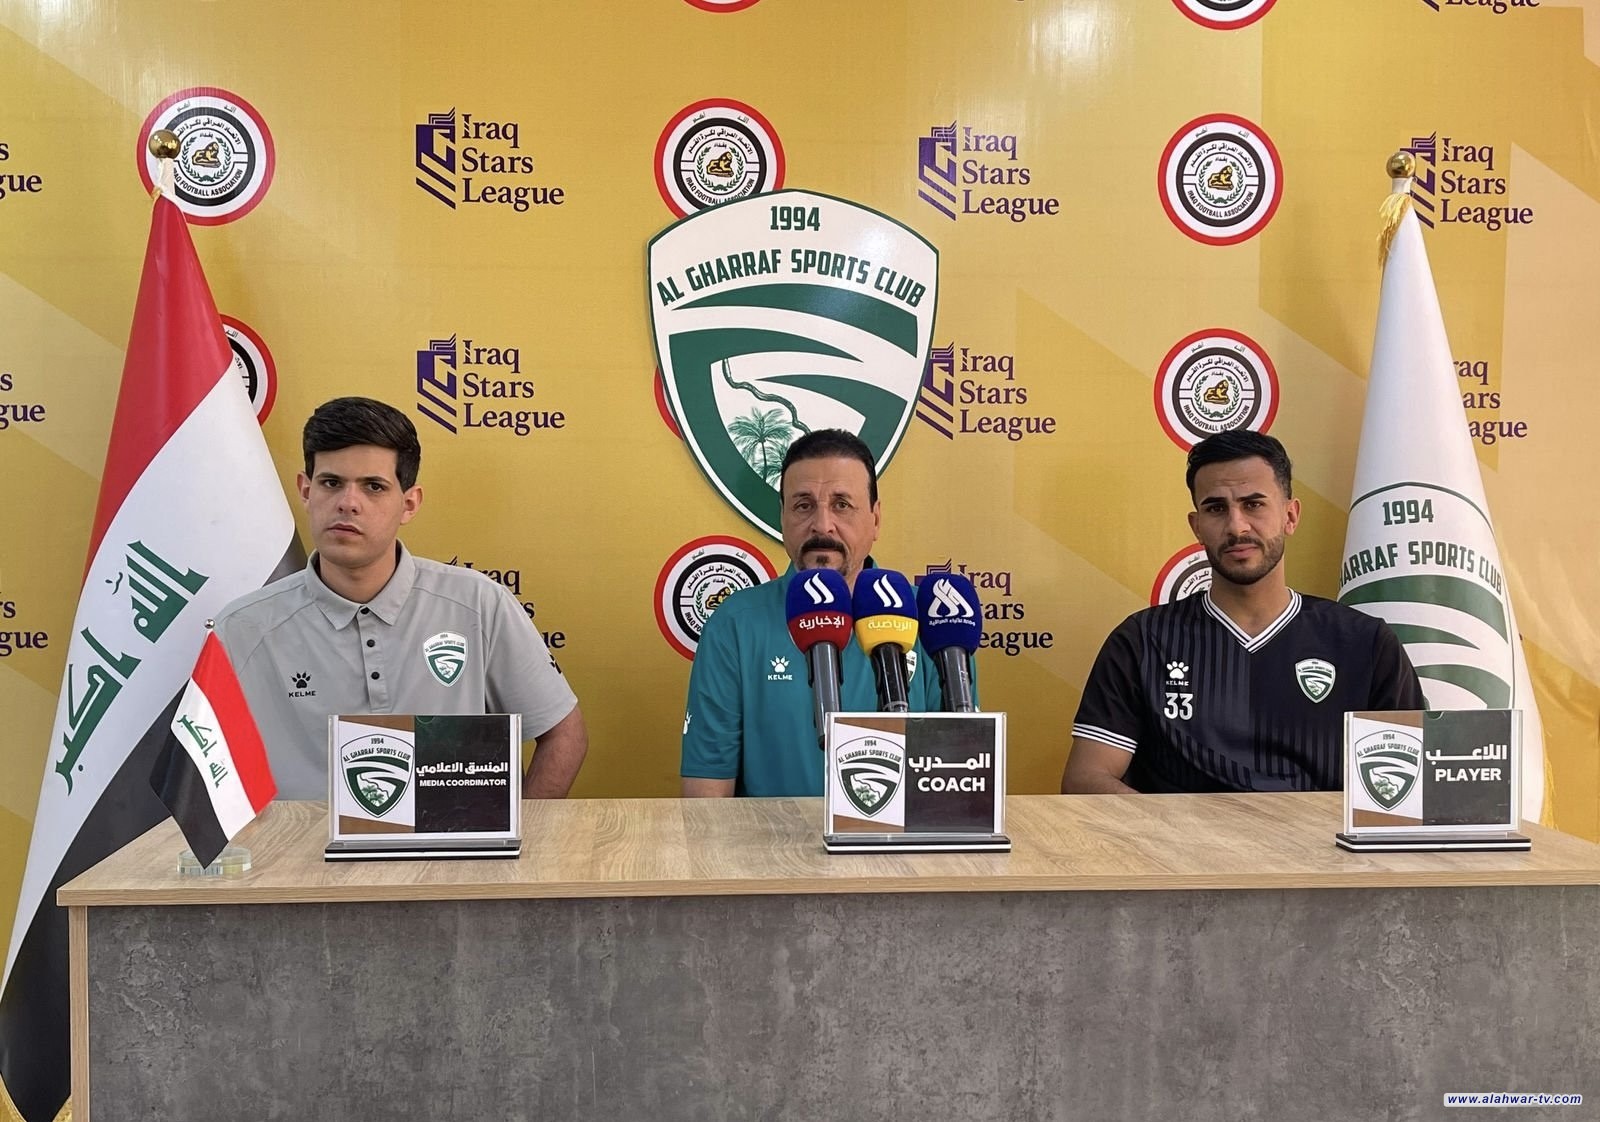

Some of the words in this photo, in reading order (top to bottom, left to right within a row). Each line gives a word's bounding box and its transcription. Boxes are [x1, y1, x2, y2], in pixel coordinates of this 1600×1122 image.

[462, 114, 520, 149] Iraq
[962, 127, 1018, 161] Iraq
[462, 147, 534, 173] Stars
[1441, 138, 1494, 171] Iraq
[181, 180, 210, 197] FOOTBALL
[211, 169, 243, 197] ASSOCIATION
[685, 176, 696, 189] IRAQ
[962, 159, 1030, 185] Stars
[1441, 169, 1506, 195] Stars
[462, 178, 565, 212] League
[962, 189, 1060, 223] League
[1187, 190, 1197, 203] IRAQ
[1196, 201, 1223, 218] FOOTBALL
[1224, 191, 1254, 217] ASSOCIATION
[770, 205, 820, 231] 1994
[1440, 199, 1533, 231] League
[656, 276, 685, 306] AL
[685, 249, 781, 291] GHARRAF
[791, 249, 871, 284] SPORTS
[874, 266, 926, 308] CLUB
[463, 339, 521, 374] Iraq
[960, 347, 1015, 381] Iraq
[463, 372, 534, 399] Stars
[1453, 360, 1489, 386] aq
[960, 379, 1028, 405] Stars
[1463, 391, 1501, 409] ars
[463, 403, 565, 437] League
[960, 409, 1056, 442] League
[1183, 404, 1193, 419] IRAQ
[1192, 416, 1219, 432] FOOTBALL
[1220, 405, 1250, 431] ASSOCIATION
[1469, 420, 1528, 445] ague
[1382, 499, 1434, 526] 1994
[1340, 543, 1398, 588] ARRAF
[1408, 541, 1475, 573] SPORTS
[1478, 556, 1502, 596] CLUB
[105, 540, 210, 644] الله
[685, 612, 694, 627] IRAQ
[799, 615, 845, 630] الإخبارية
[982, 602, 1025, 620] ars
[867, 619, 913, 632] الرياضية
[979, 631, 1054, 656] eague
[288, 690, 317, 698] KELME
[1164, 692, 1194, 720] 33
[376, 747, 397, 756] SPORTS
[397, 751, 412, 761] CLUB
[869, 749, 889, 757] SPORTS
[908, 752, 991, 773] المدرب
[1425, 743, 1507, 766] اللاعب
[415, 761, 463, 777] الاعلامي
[465, 761, 508, 775] المنسق
[1435, 767, 1502, 782] PLAYER
[420, 779, 446, 787] MEDIA
[446, 778, 507, 787] COORDINATOR
[917, 777, 986, 792] COACH
